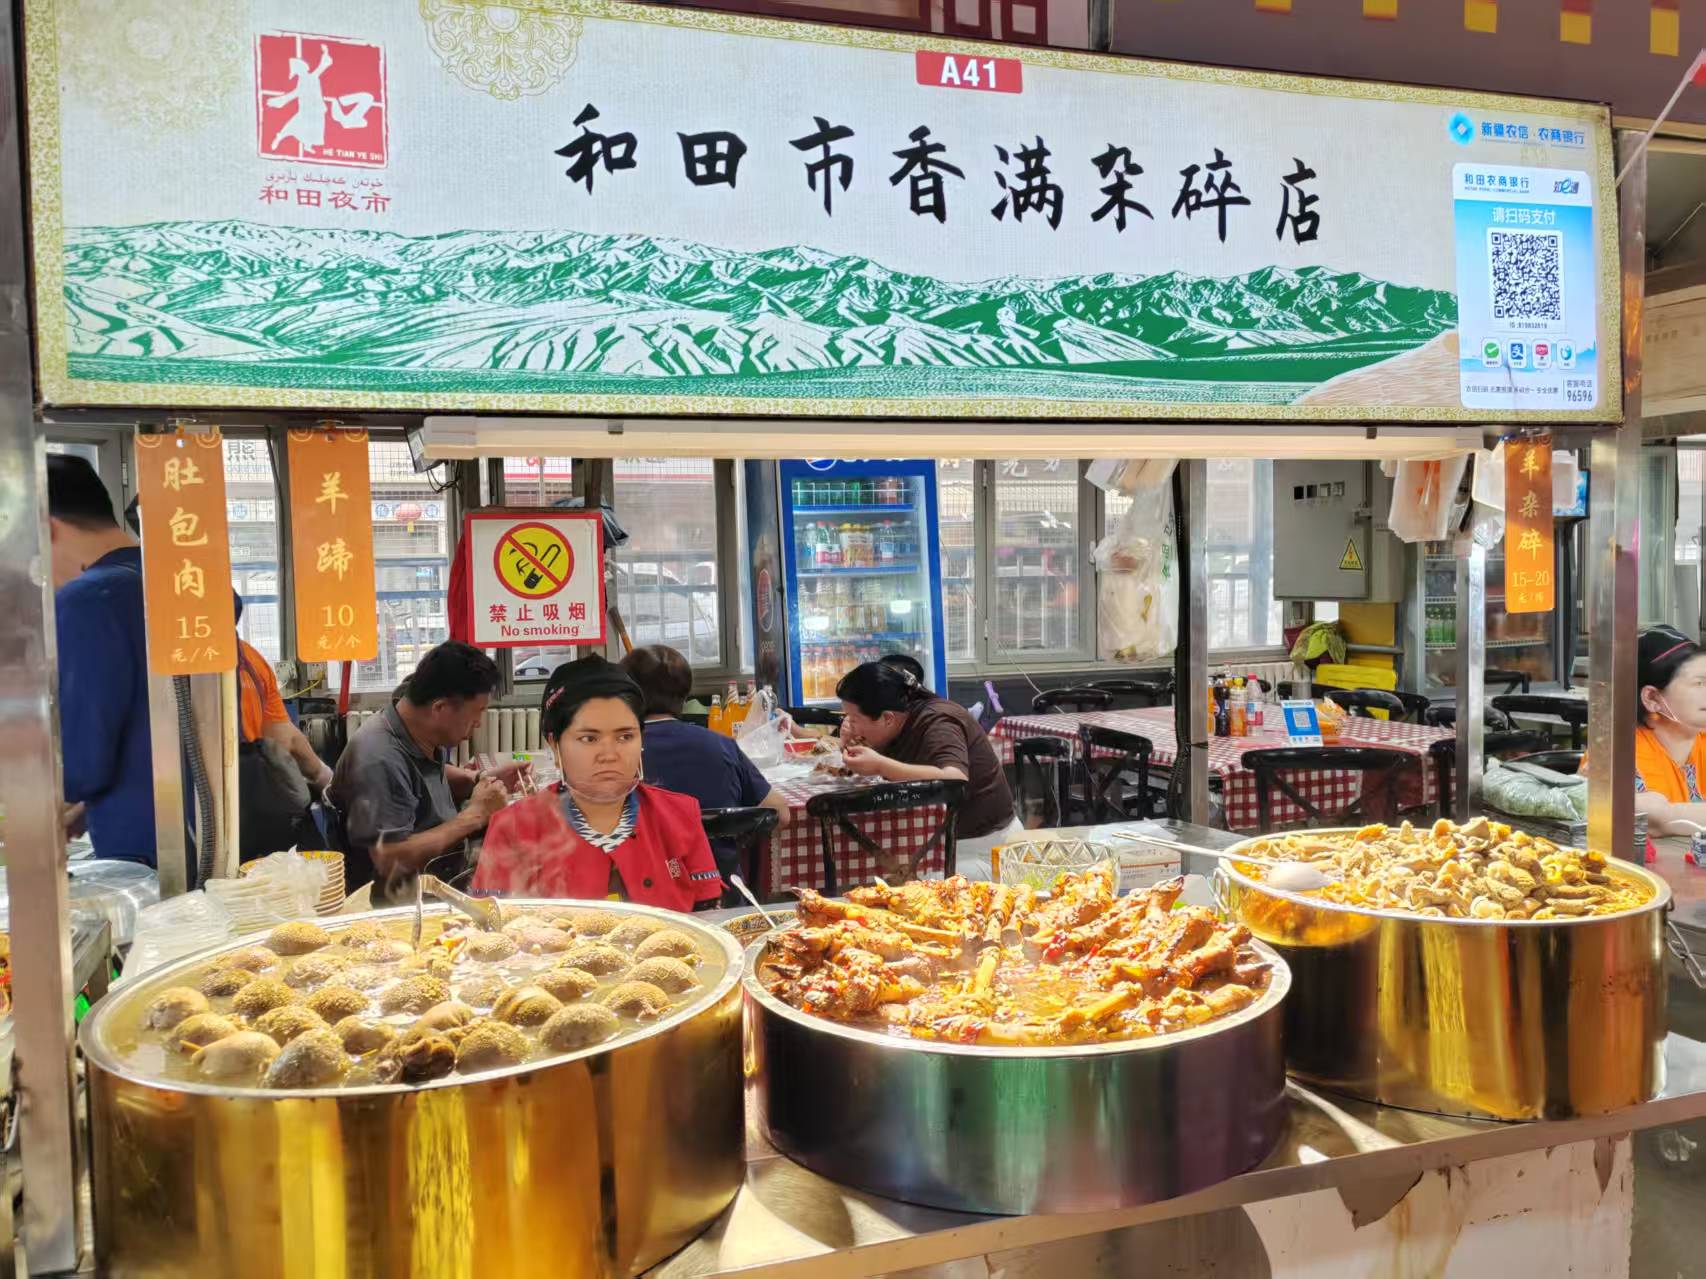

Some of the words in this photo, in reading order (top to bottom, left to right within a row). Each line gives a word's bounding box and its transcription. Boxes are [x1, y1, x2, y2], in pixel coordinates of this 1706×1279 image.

[940, 56, 999, 90] A41
[322, 148, 334, 156] HE
[336, 149, 355, 158] TIAN
[554, 102, 1321, 245] 和田市香满杂碎店
[1464, 173, 1530, 189] 和田农商银行
[259, 184, 392, 213] 和田夜市
[1491, 207, 1556, 226] 请扫码支付
[1566, 390, 1593, 402] 96596
[1518, 449, 1544, 561] 羊杂碎
[163, 457, 208, 599] 肚包肉
[315, 472, 353, 582] 羊蹄
[1512, 570, 1550, 587] 15-20
[1518, 591, 1545, 604] 元/
[322, 604, 354, 627] 10
[489, 602, 586, 623] 禁止吸烟
[176, 615, 212, 639] 15
[501, 625, 520, 637] No
[523, 623, 580, 637] smoking
[317, 635, 360, 650] 元/个
[172, 647, 220, 663] 元/个
